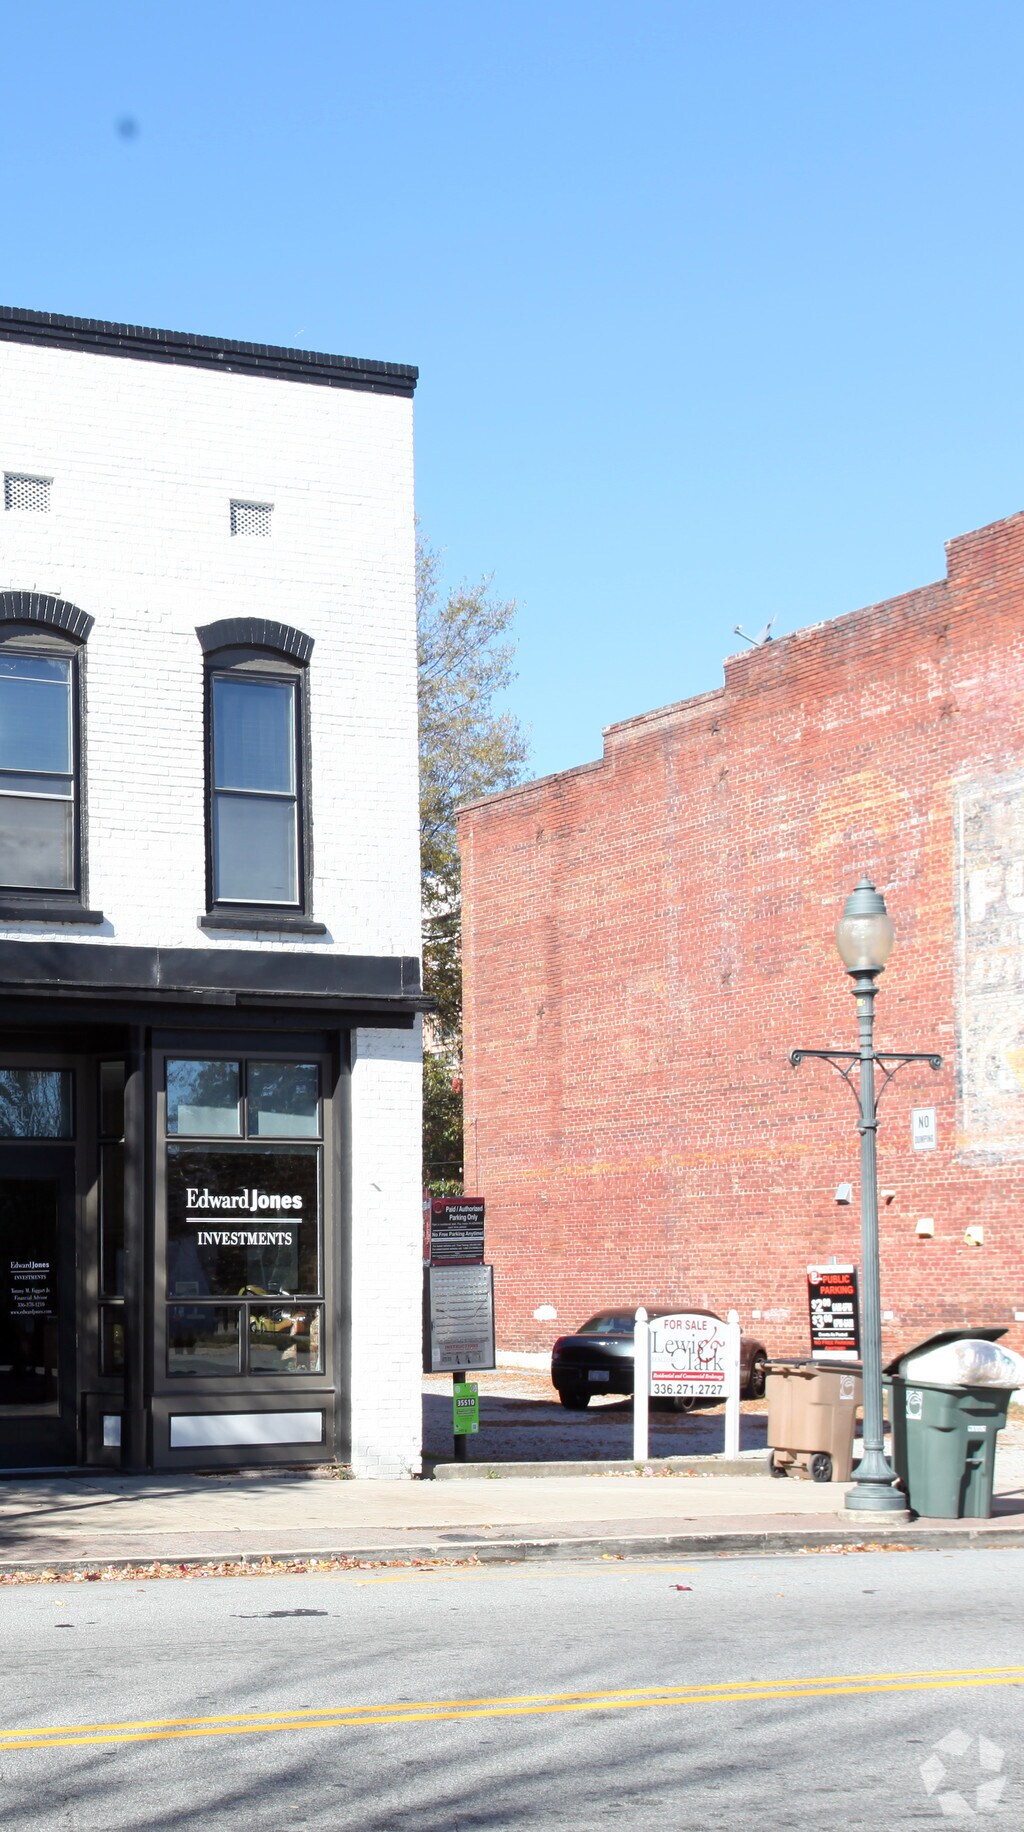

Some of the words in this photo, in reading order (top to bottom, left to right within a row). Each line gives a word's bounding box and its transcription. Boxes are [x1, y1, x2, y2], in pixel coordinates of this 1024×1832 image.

[918, 1115, 929, 1128] NO
[197, 1231, 293, 1246] INVESTMENTS
[823, 1275, 851, 1284] PUBLIC
[820, 1285, 854, 1295] PARKING
[664, 1320, 682, 1330] FOR
[685, 1320, 708, 1330] SALE
[652, 1331, 704, 1354] Lewis
[671, 1347, 724, 1371] Clark
[654, 1383, 723, 1395] 336.271.2727
